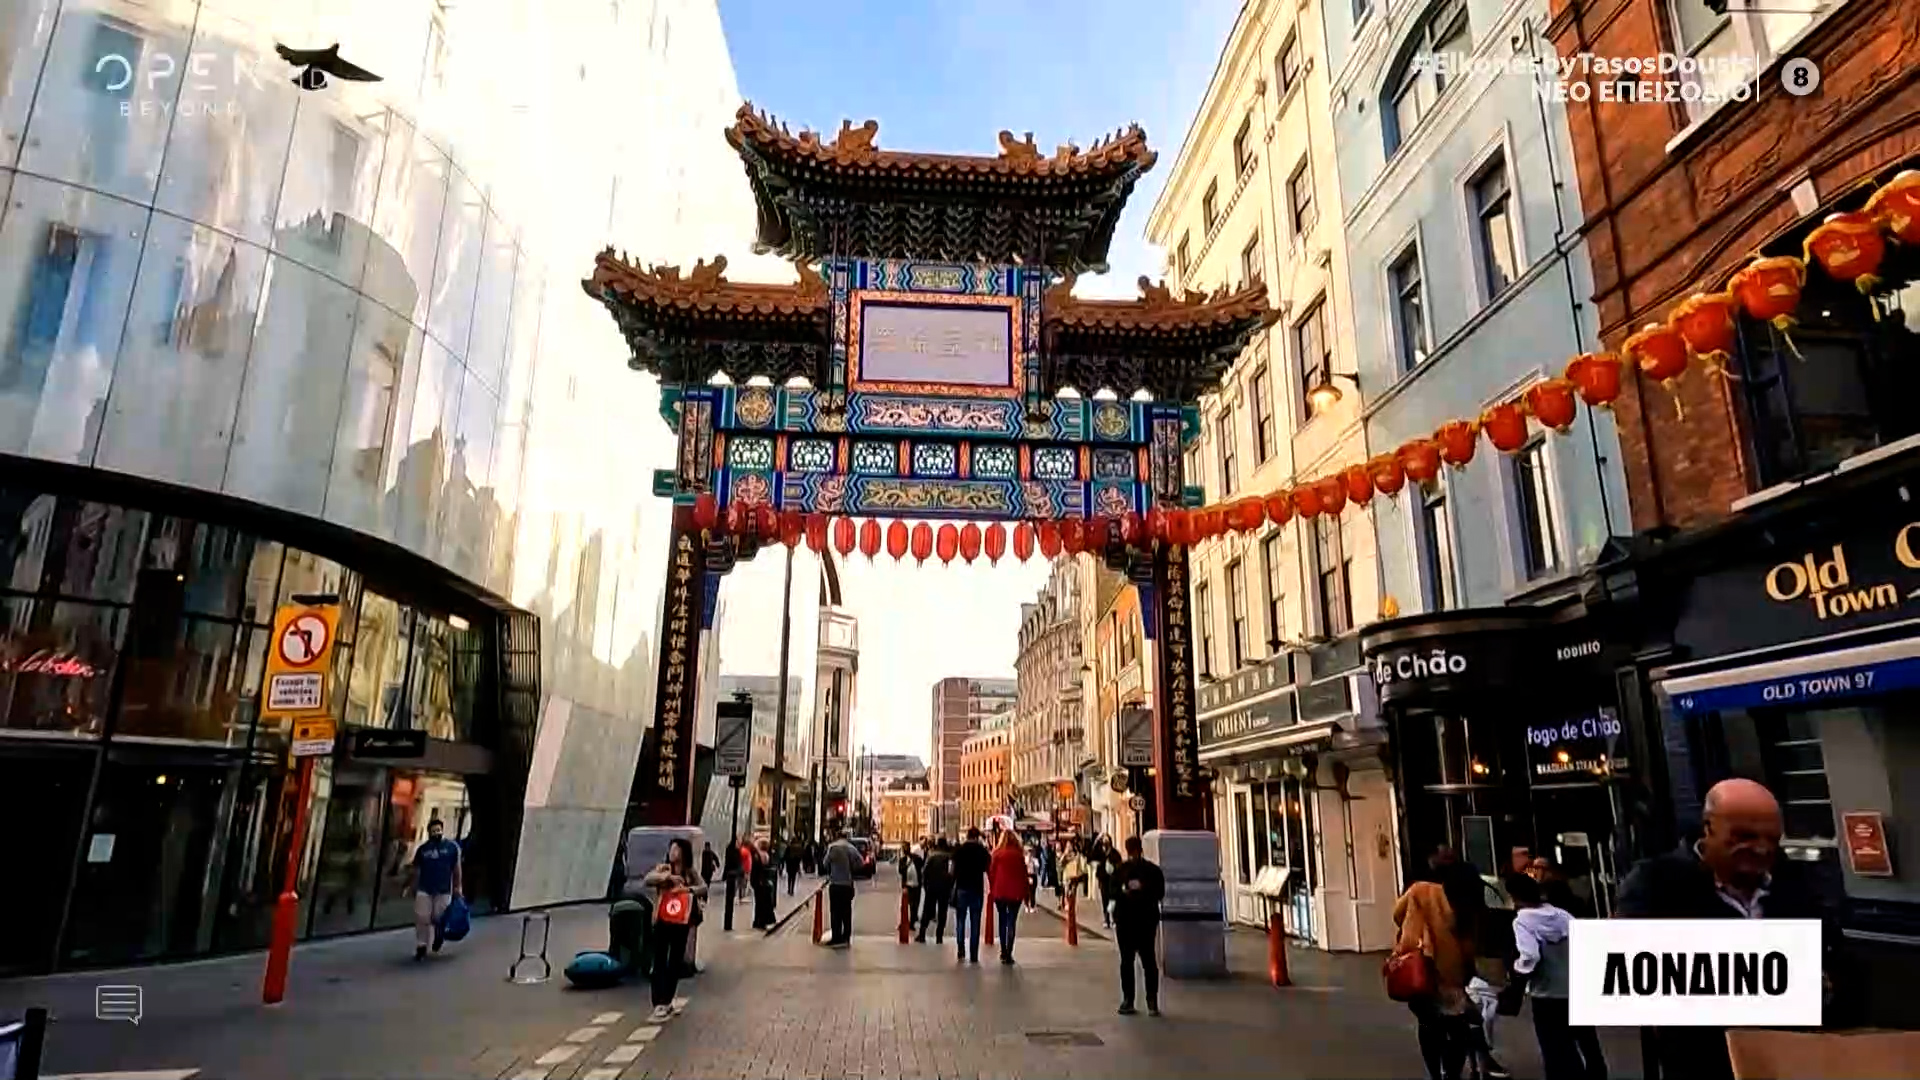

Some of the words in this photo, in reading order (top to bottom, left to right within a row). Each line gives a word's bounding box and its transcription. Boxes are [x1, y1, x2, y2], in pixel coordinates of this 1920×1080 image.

[1766, 544, 1849, 601] Old
[1810, 583, 1898, 620] Town
[1376, 654, 1392, 684] de
[1397, 649, 1467, 679] Chão
[1763, 682, 1795, 701] OLD
[1801, 676, 1851, 696] TOWN
[1855, 671, 1875, 690] 97
[1561, 720, 1578, 740] de
